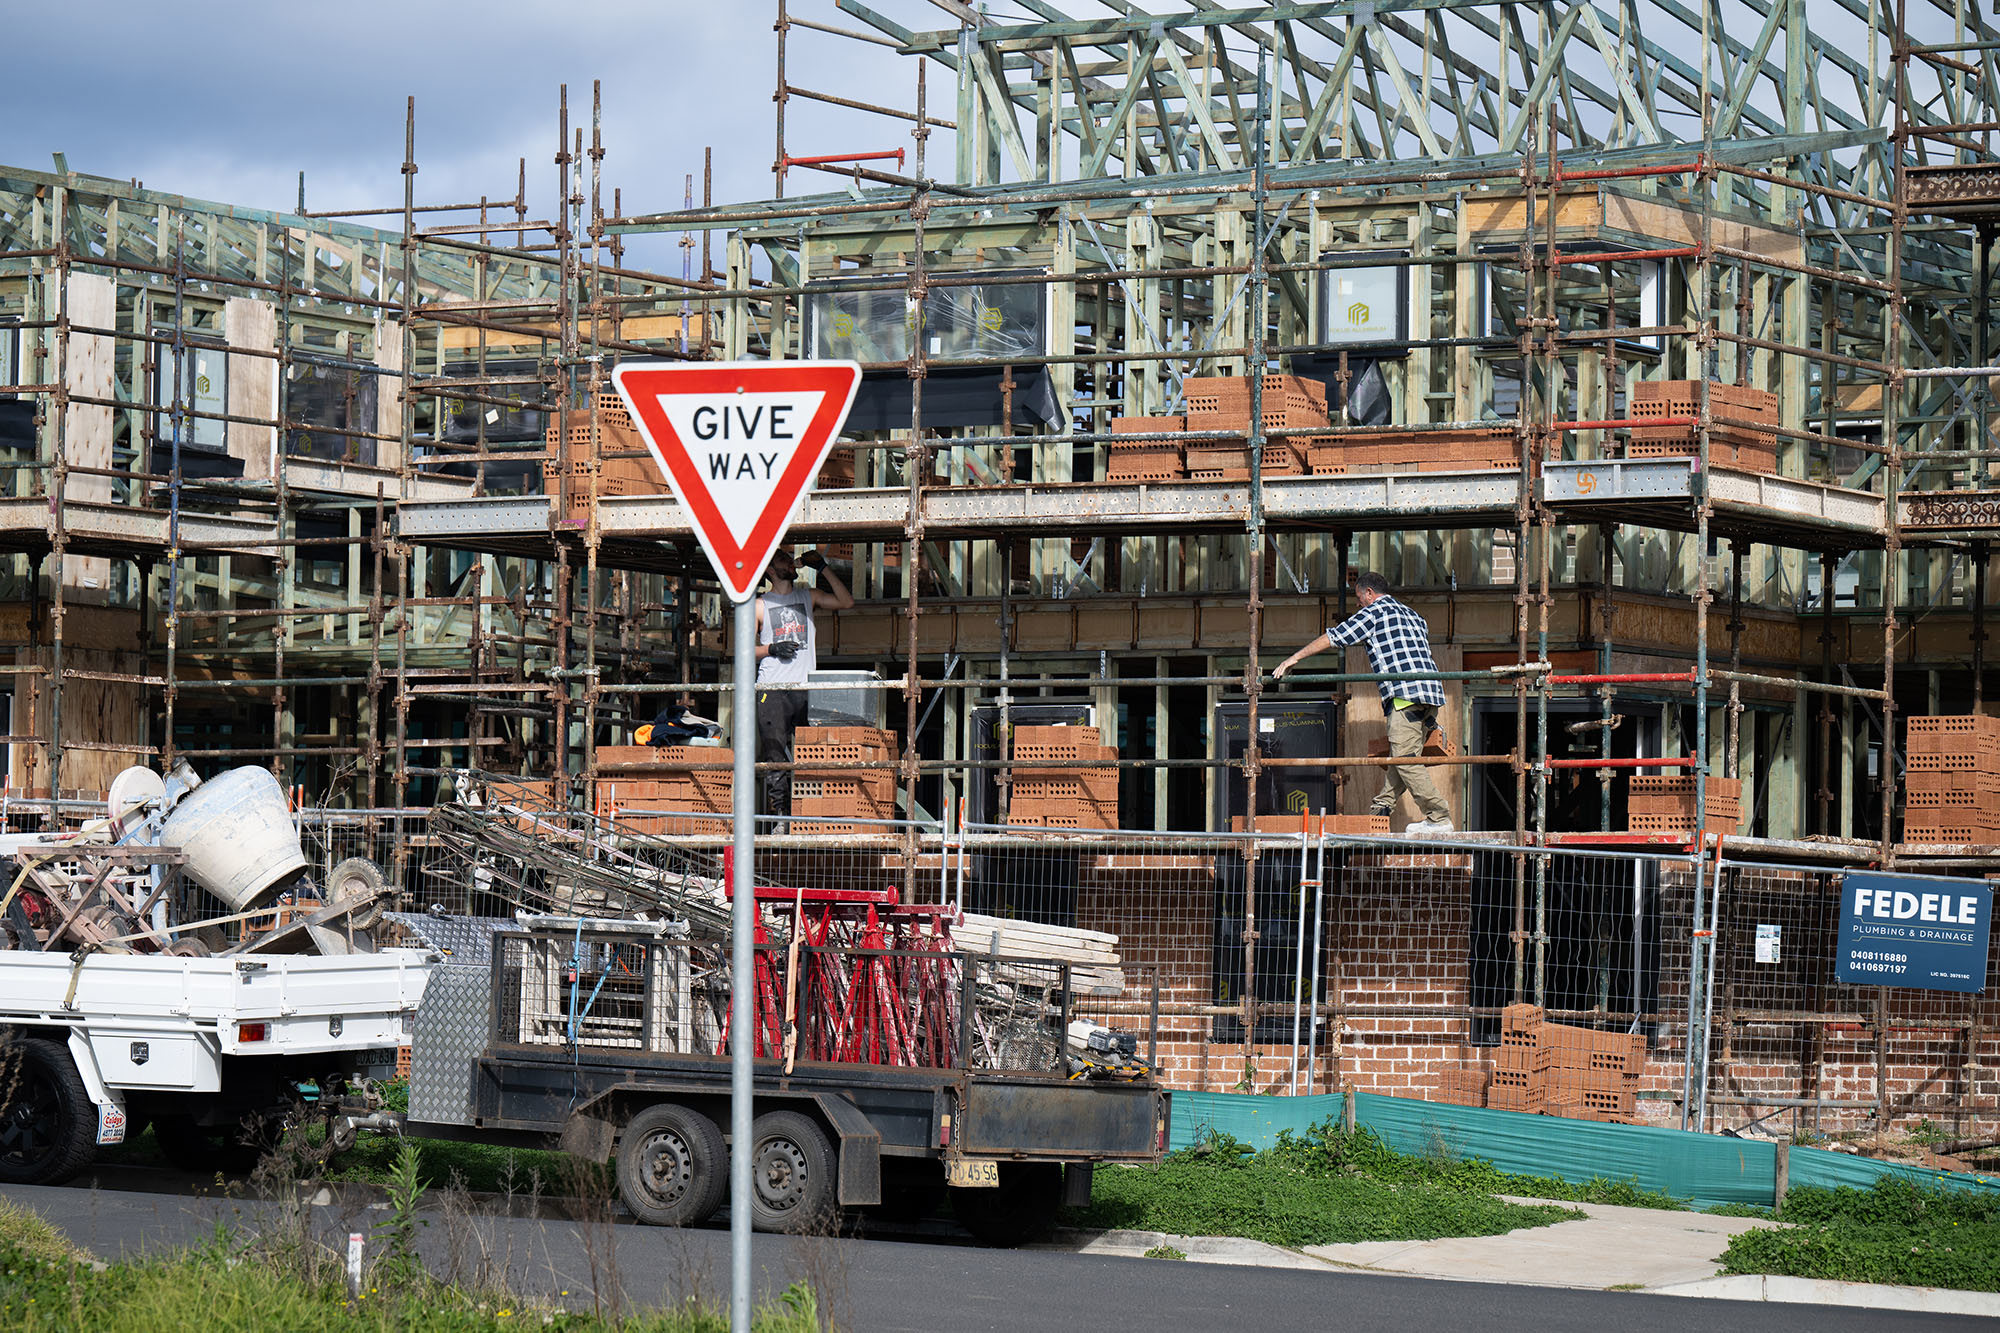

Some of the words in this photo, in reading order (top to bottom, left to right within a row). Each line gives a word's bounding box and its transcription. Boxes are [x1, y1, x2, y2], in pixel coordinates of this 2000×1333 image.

[693, 405, 793, 440] GIVE
[709, 453, 778, 480] WAY
[1854, 888, 1978, 925] FEDELE
[1852, 924, 1905, 936] PLUMBING
[1909, 929, 1915, 937] &
[1919, 930, 1974, 942] DRAINAGE
[1850, 961, 1907, 974] 0410697197
[1851, 950, 1907, 963] 0408116880
